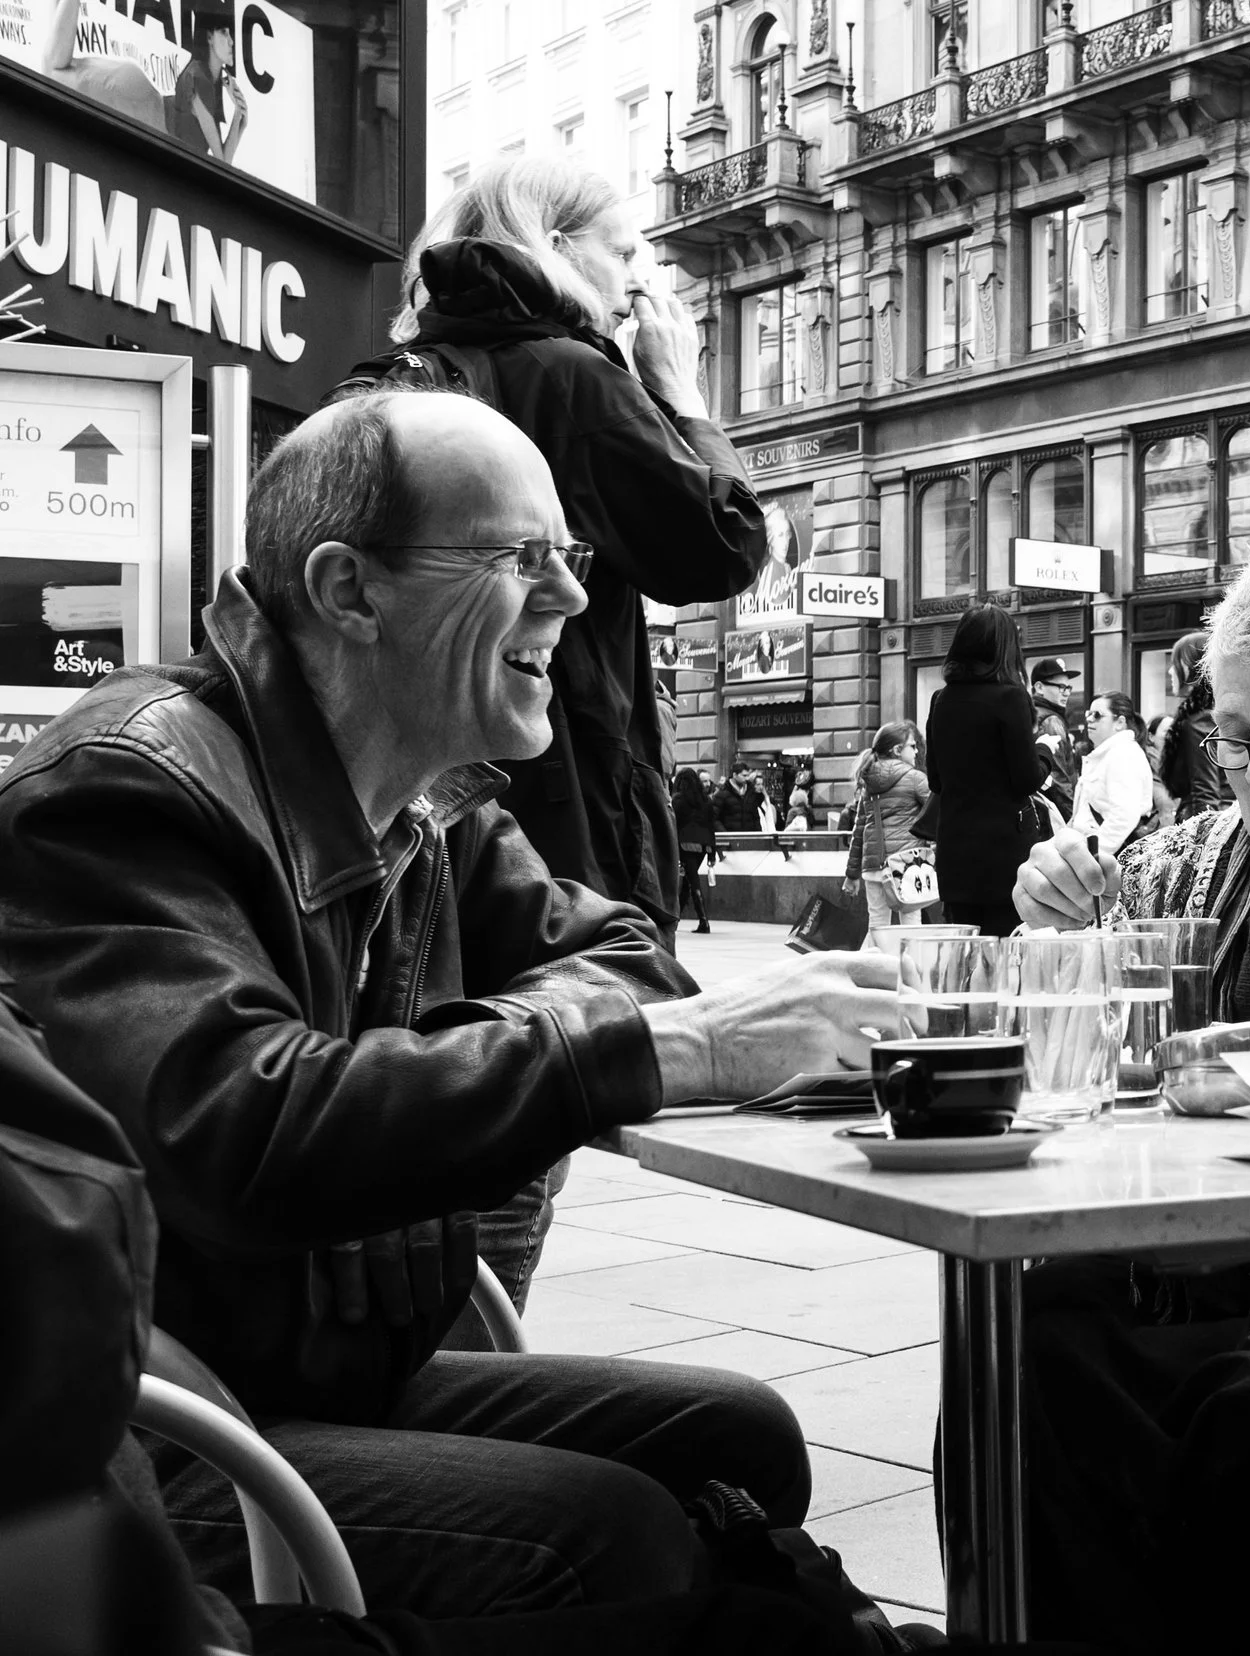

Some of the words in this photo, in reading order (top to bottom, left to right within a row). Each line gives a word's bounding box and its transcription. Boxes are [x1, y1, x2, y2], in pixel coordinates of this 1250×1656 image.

[76, 21, 109, 56] WAY
[0, 139, 306, 363] UMANIC
[757, 439, 821, 467] SOUVENIRS
[47, 491, 135, 519] 500m
[1036, 567, 1079, 582] ROLEX
[808, 582, 879, 606] claire's
[54, 639, 85, 656] Art
[53, 656, 115, 677] &Style
